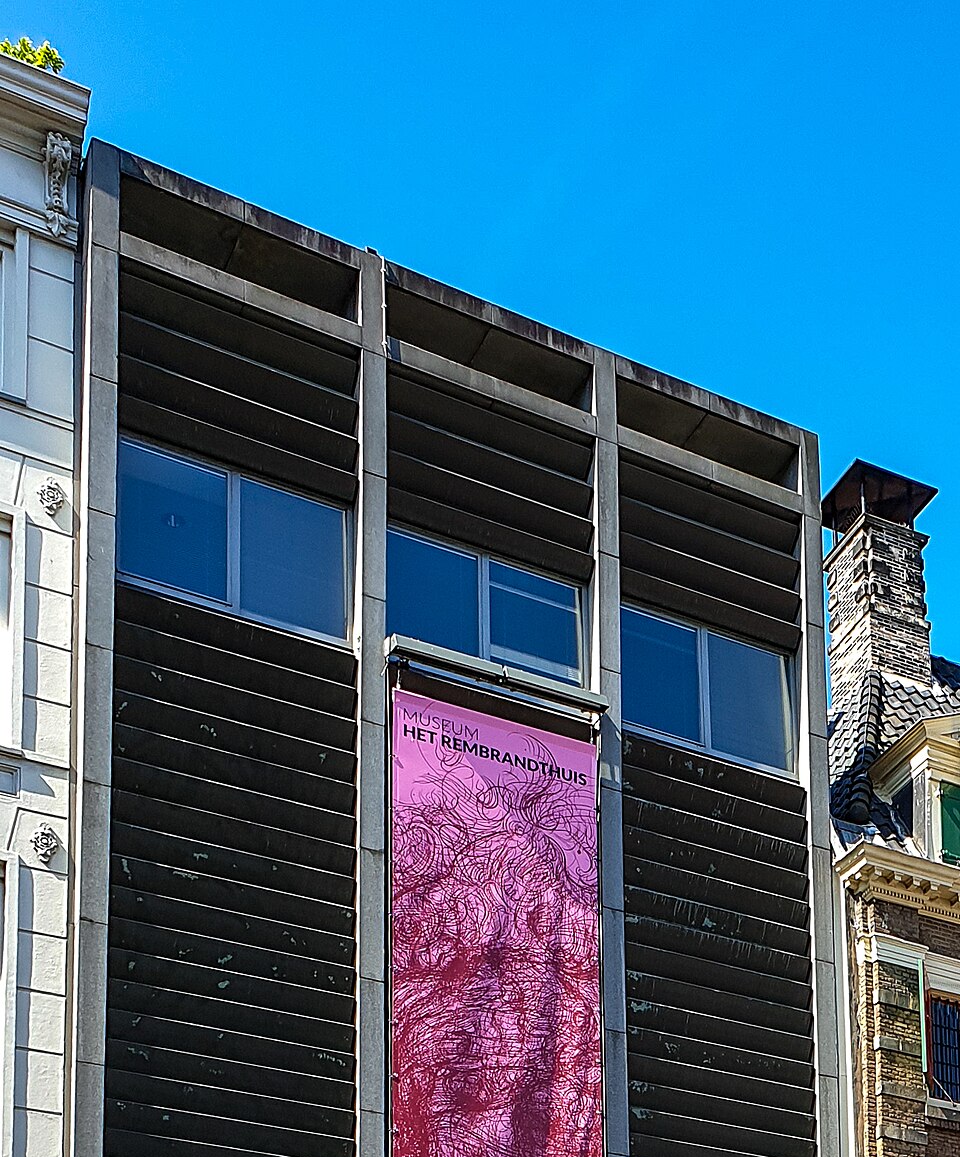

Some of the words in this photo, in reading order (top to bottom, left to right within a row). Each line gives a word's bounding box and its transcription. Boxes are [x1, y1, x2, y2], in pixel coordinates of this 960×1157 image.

[403, 708, 479, 741] MUSEUM
[403, 724, 438, 745] HET
[441, 735, 587, 786] REMBRANDTHUIS
